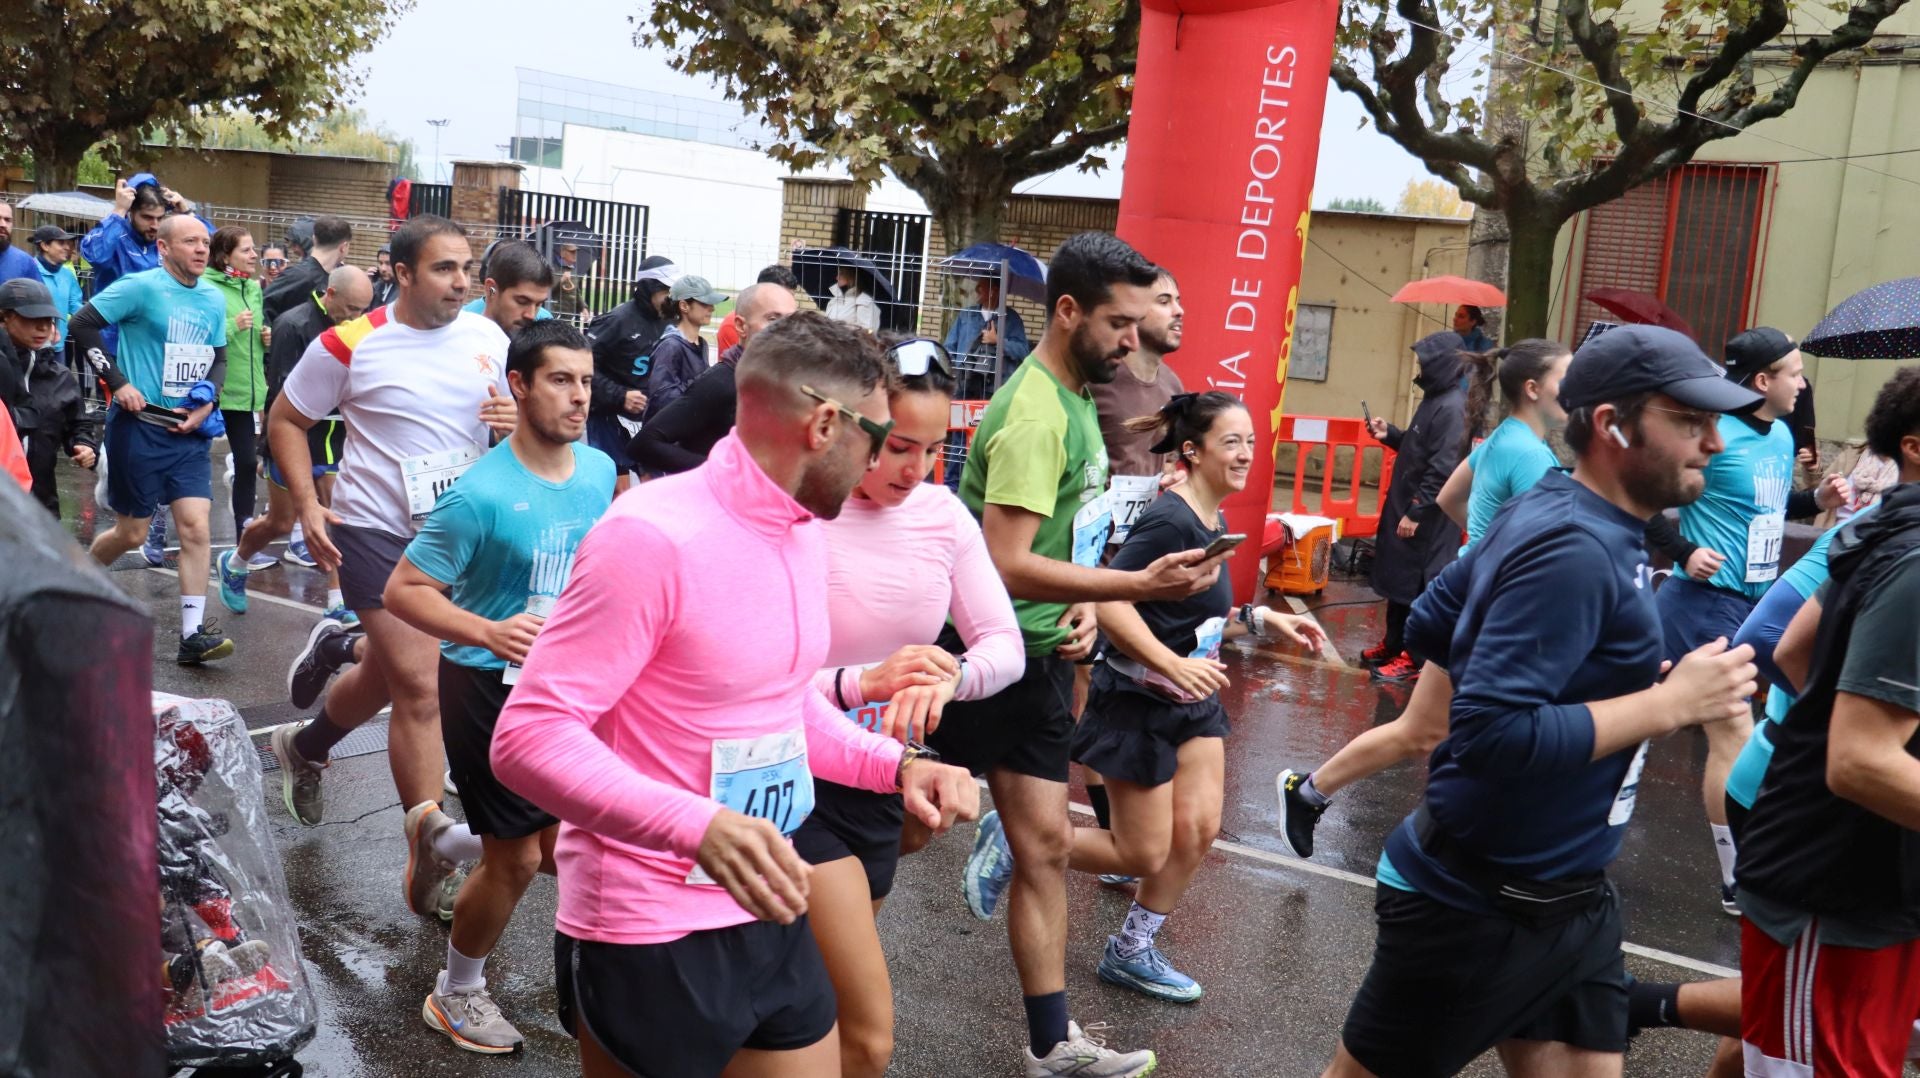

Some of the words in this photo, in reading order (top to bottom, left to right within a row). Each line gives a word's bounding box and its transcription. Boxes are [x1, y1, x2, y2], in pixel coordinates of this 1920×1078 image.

[1236, 45, 1297, 260] DEPORTES
[1225, 278, 1262, 332] DE
[176, 362, 206, 382] 1043
[1207, 351, 1250, 402] ÍA
[1123, 498, 1152, 524] 73
[744, 780, 794, 832] 407
